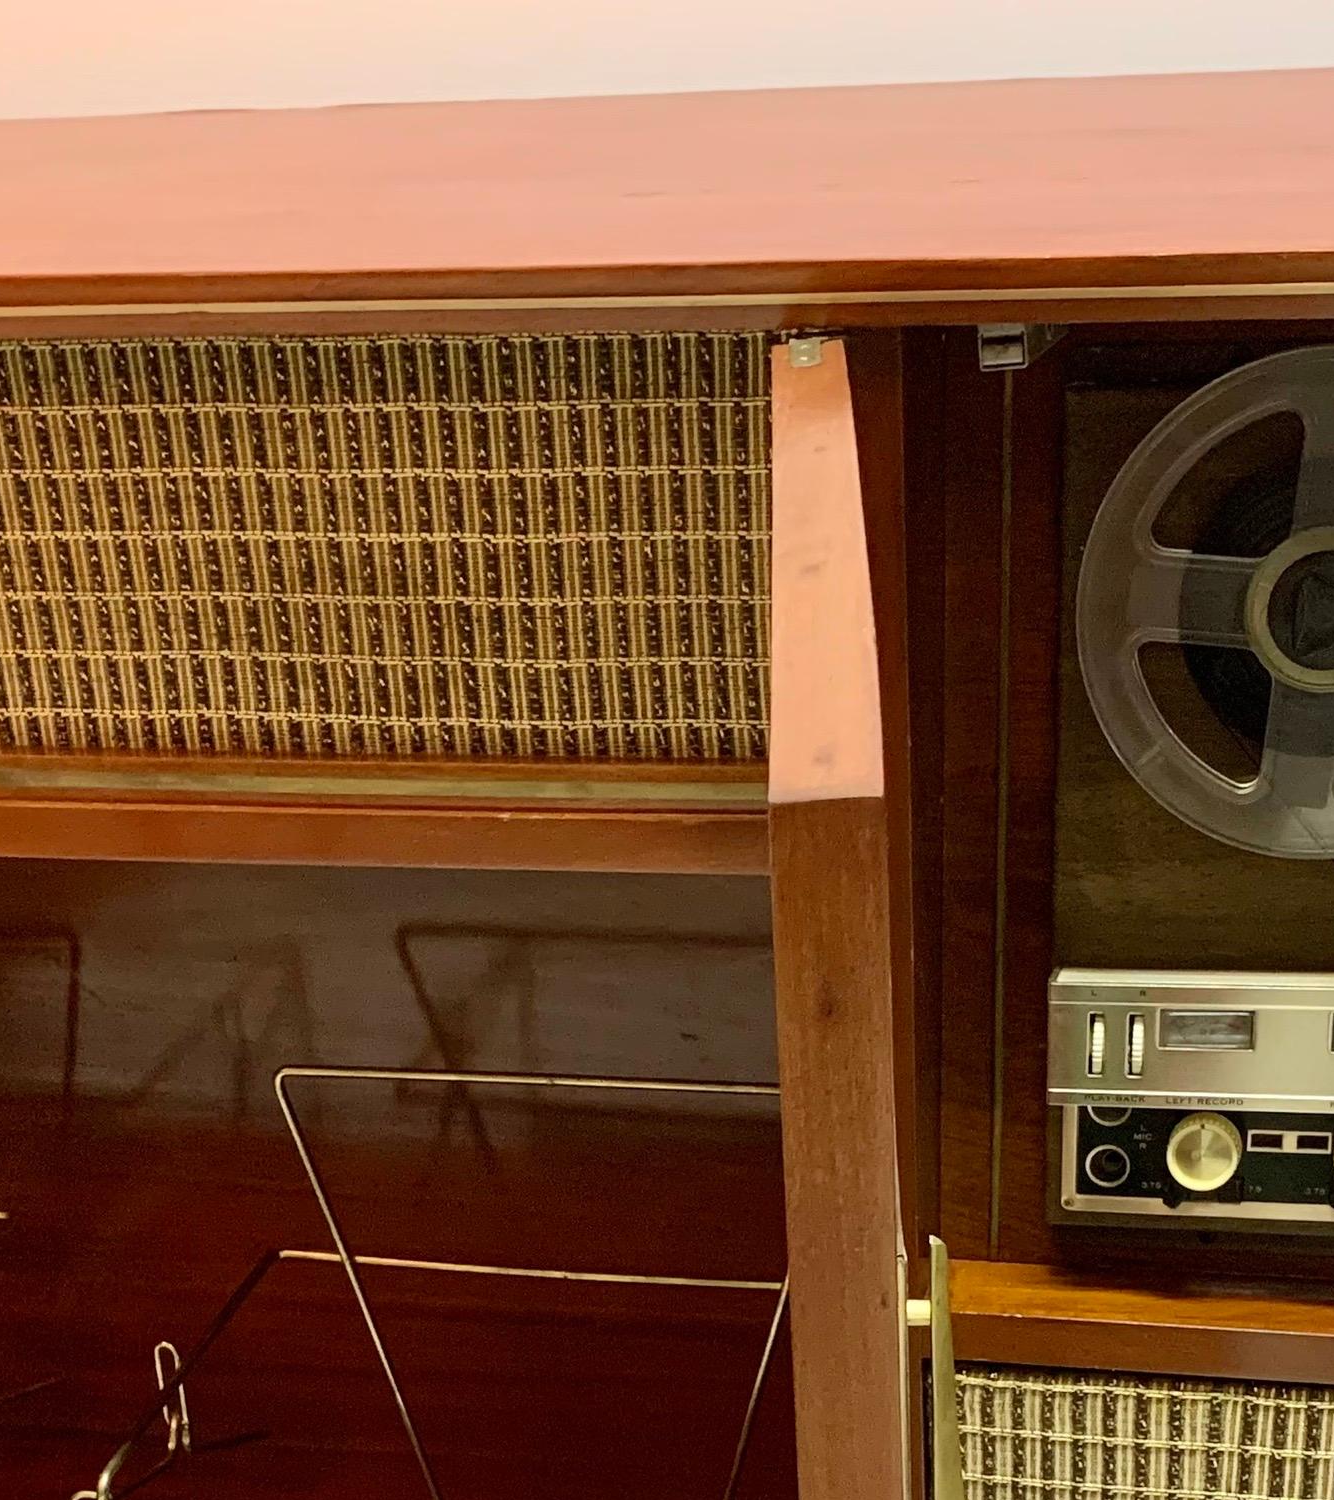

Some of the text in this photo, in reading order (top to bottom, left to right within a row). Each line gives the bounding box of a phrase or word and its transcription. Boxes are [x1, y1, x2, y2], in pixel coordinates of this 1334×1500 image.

[1165, 1097, 1244, 1106] LEFT RECORD
[1133, 1132, 1153, 1142] MIC
